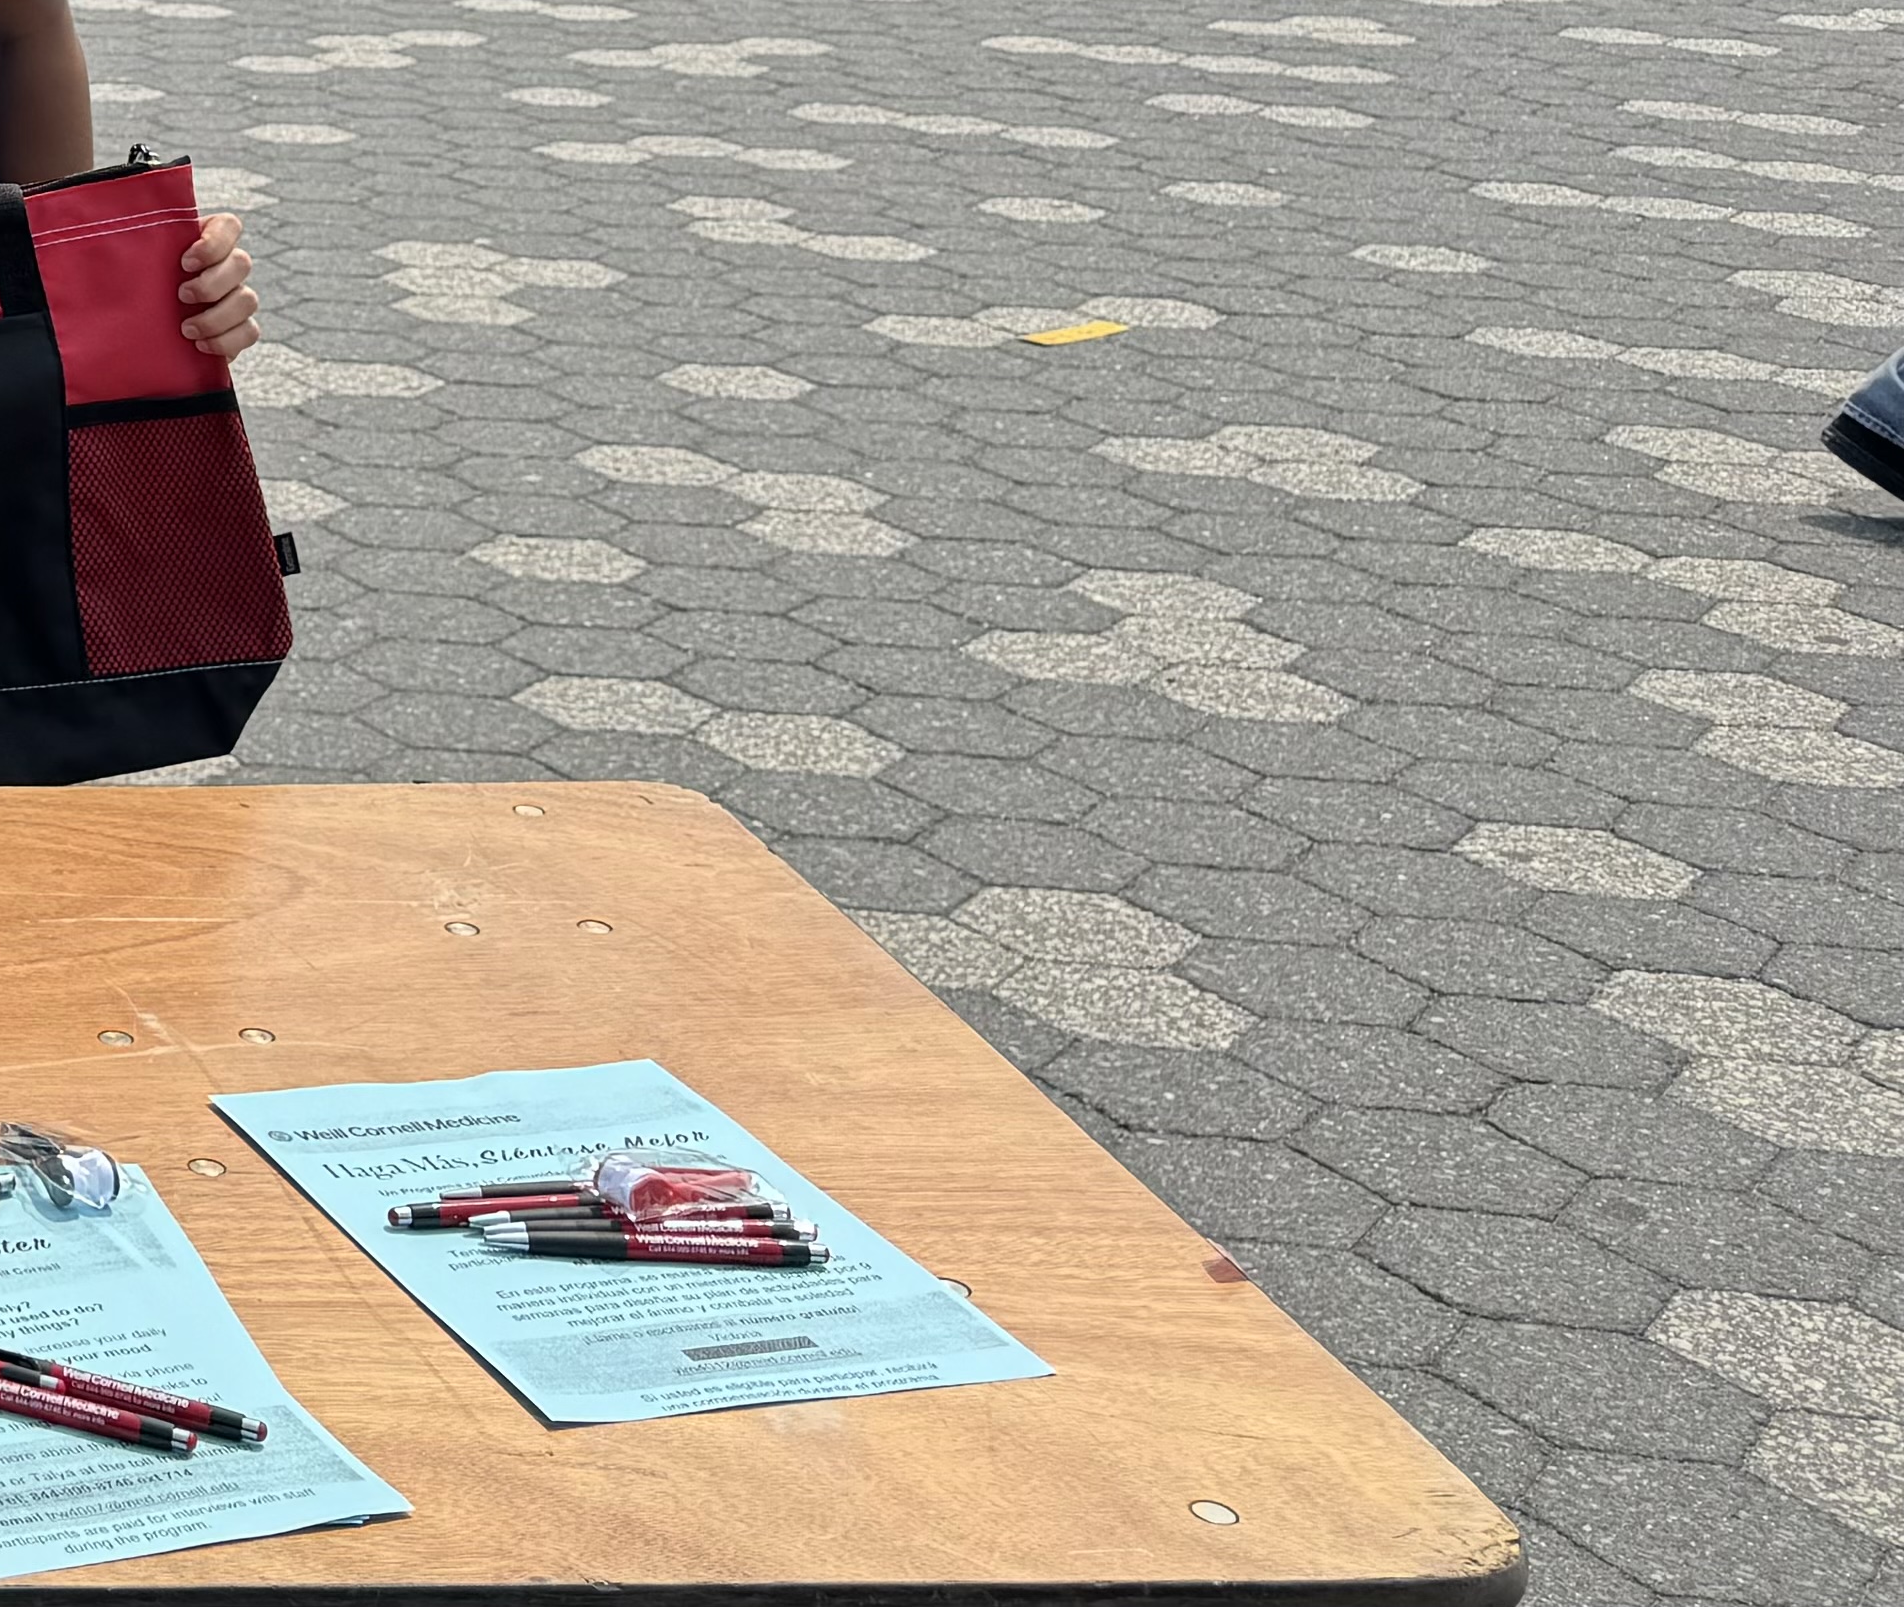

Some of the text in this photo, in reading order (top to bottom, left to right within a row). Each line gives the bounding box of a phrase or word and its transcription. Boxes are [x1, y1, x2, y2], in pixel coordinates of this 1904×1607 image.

[293, 1113, 522, 1142] Weill Cornell Medicine
[85, 1525, 108, 1538] are
[112, 1516, 142, 1533] paid
[146, 1513, 167, 1526] for
[171, 1501, 247, 1520] interviews
[250, 1494, 280, 1507] with
[283, 1488, 316, 1501] staff
[64, 1538, 113, 1556] during
[116, 1533, 141, 1546] the
